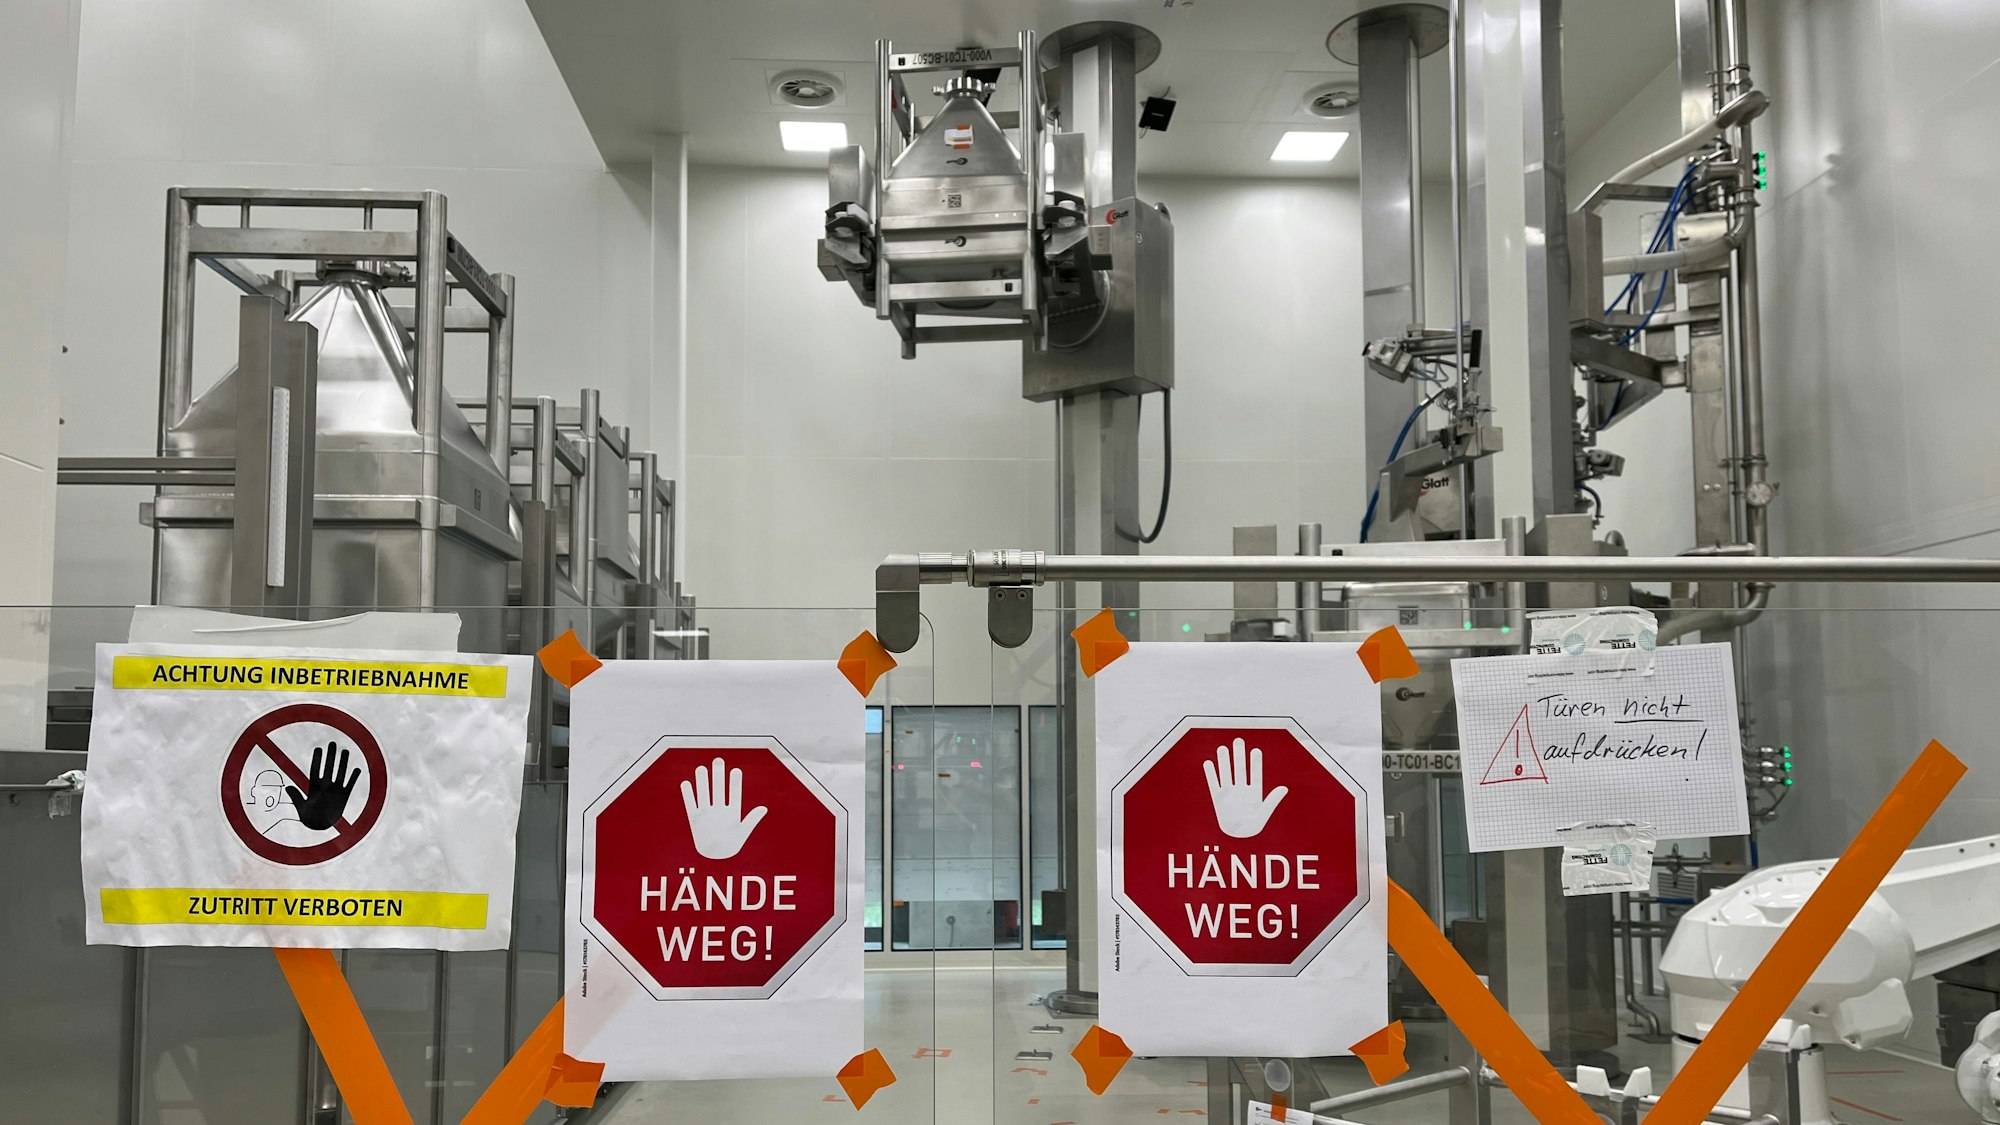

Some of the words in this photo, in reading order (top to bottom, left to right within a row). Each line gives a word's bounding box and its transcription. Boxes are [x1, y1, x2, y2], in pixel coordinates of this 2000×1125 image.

[1537, 647, 1561, 655] FETTE
[152, 664, 263, 684] ACHTUNG
[270, 666, 469, 690] INBETRIEBNAHME
[1538, 693, 1605, 719] Türen
[1624, 694, 1692, 717] nicht
[1382, 754, 1460, 770] 0-TC01-BC1
[1543, 728, 1708, 781] aufdrücken!
[1168, 845, 1320, 889] HÄNDE
[1583, 857, 1608, 865] FETTE
[640, 867, 797, 911] HÄNDE
[189, 896, 278, 915] ZUTRITT
[283, 898, 402, 917] VERBOTEN
[1184, 902, 1298, 939] WEG!
[656, 925, 773, 961] WEG!
